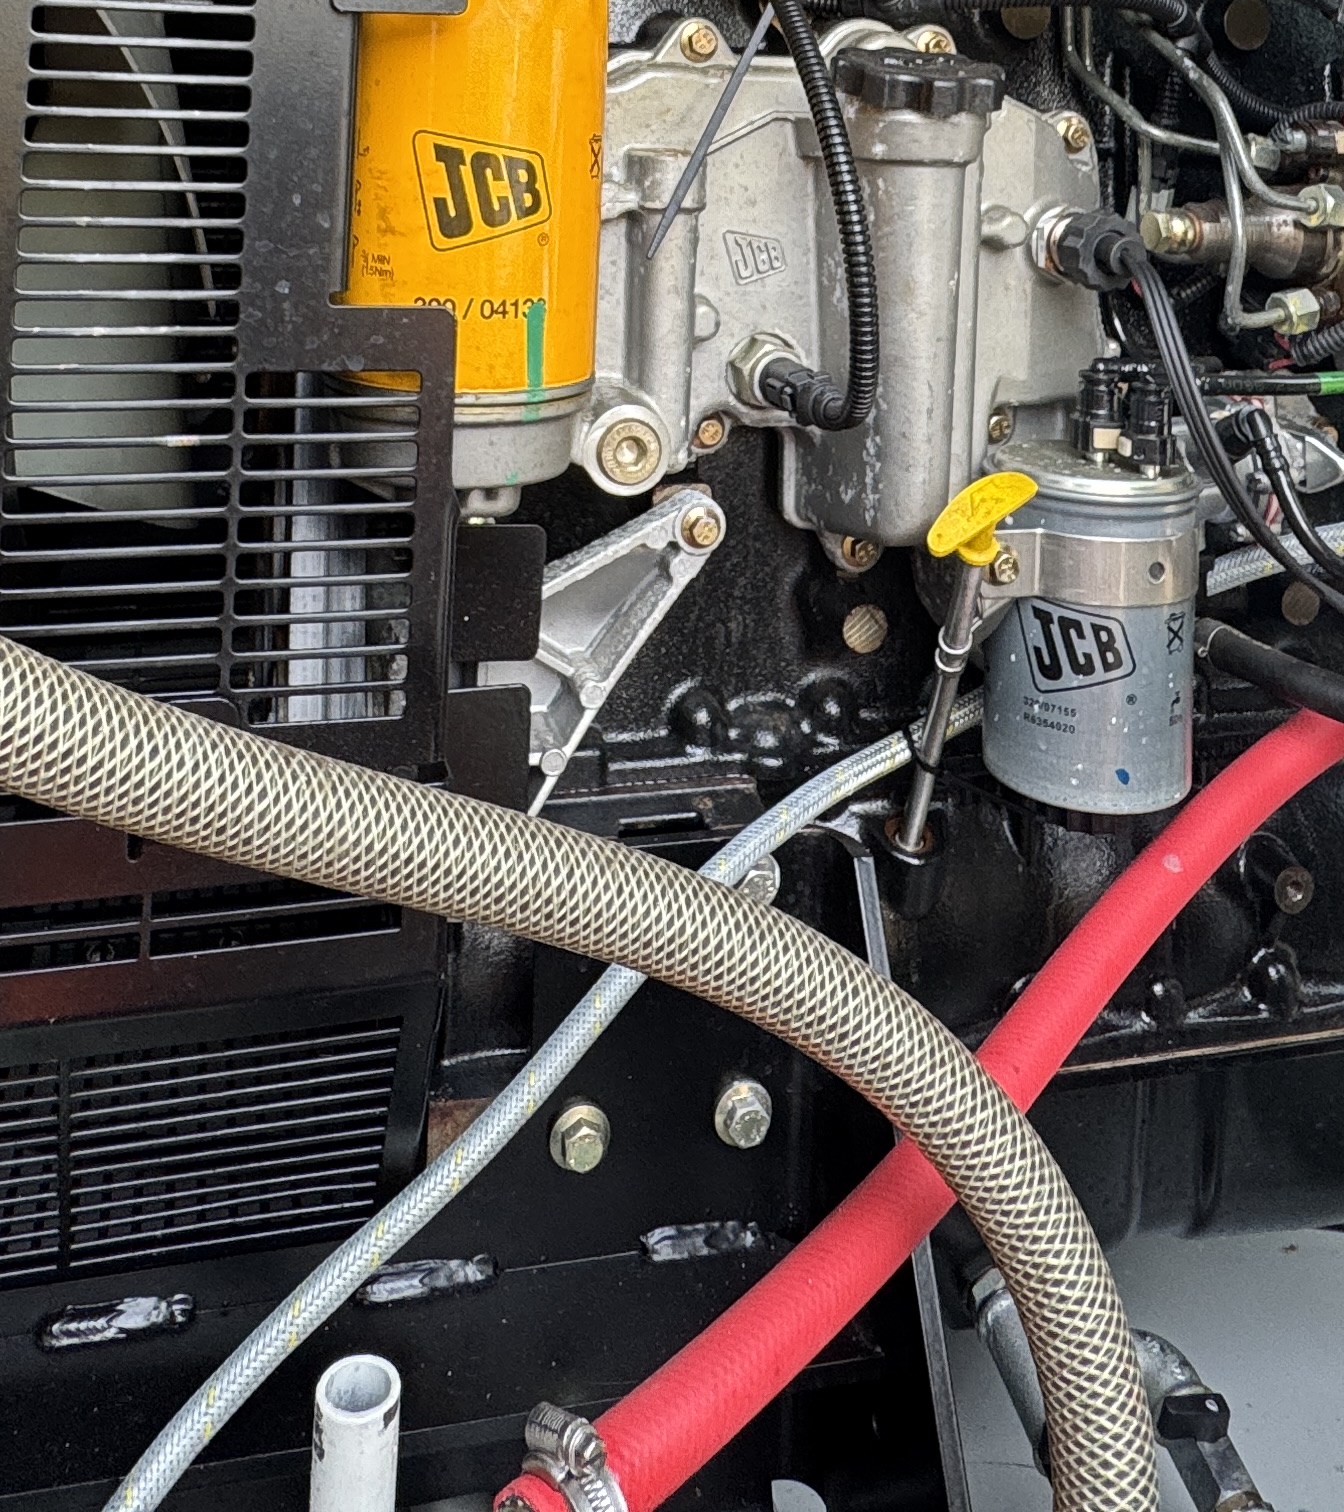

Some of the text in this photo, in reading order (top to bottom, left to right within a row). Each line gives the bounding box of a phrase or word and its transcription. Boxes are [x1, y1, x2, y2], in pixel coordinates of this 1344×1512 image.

[432, 141, 543, 240] JCB
[733, 234, 784, 280] JCB
[1031, 604, 1123, 682] JCB
